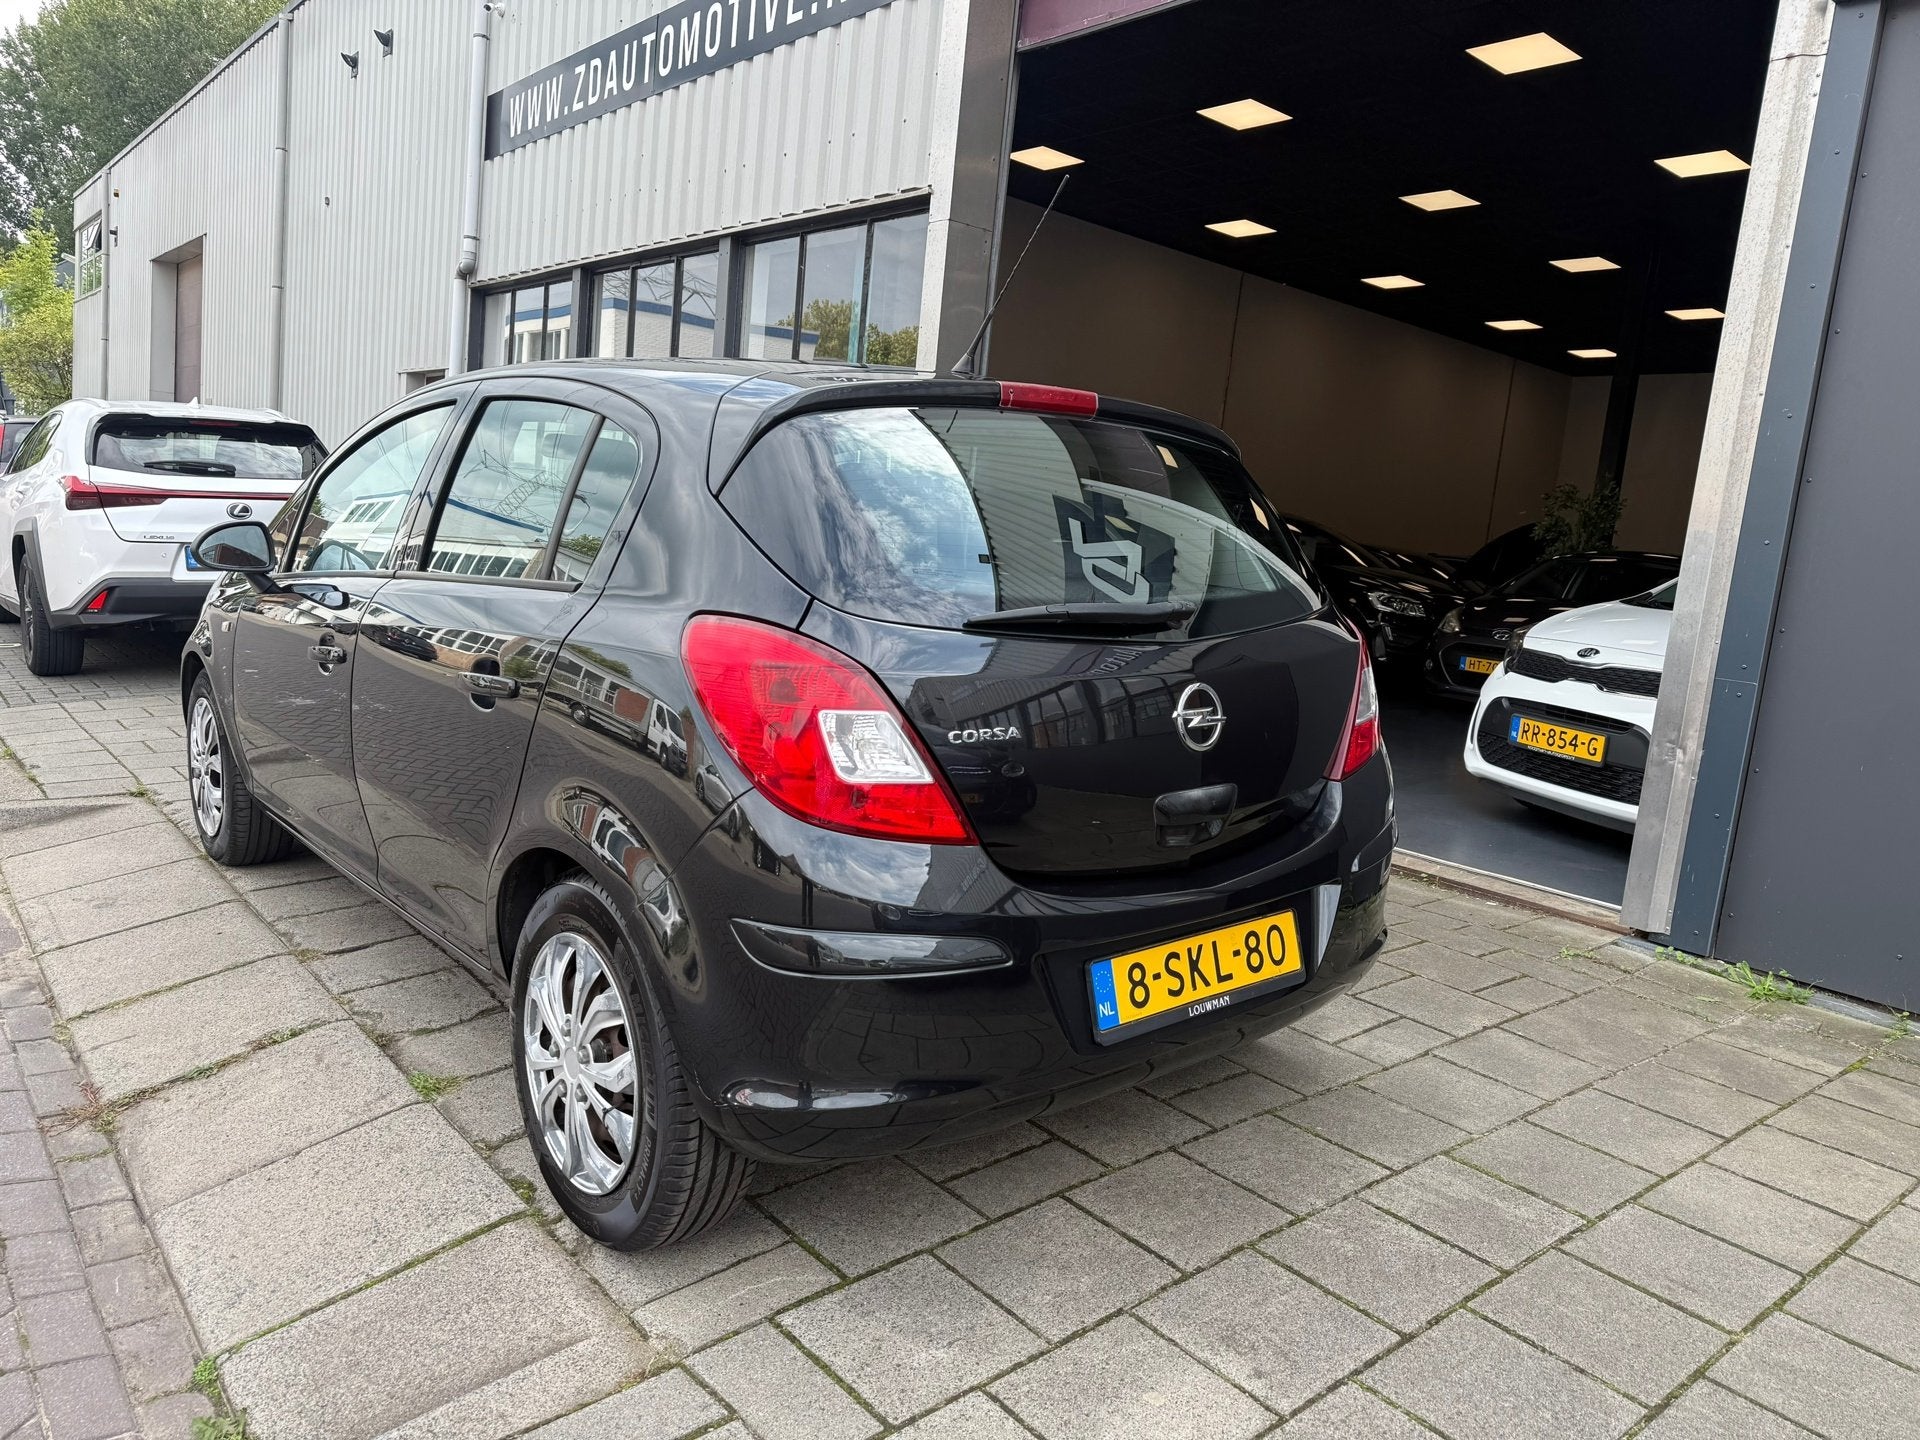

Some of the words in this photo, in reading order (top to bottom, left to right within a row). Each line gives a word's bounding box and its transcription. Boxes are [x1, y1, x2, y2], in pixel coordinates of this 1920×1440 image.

[509, 0, 847, 139] WWW.ZDAUTOMOTIV.
[947, 726, 1022, 744] CORSA
[1521, 722, 1599, 757] RR-854-G
[1127, 924, 1286, 1009] 8-SKL-80
[1099, 1001, 1115, 1018] NL
[1188, 995, 1231, 1017] LOUWMAN
